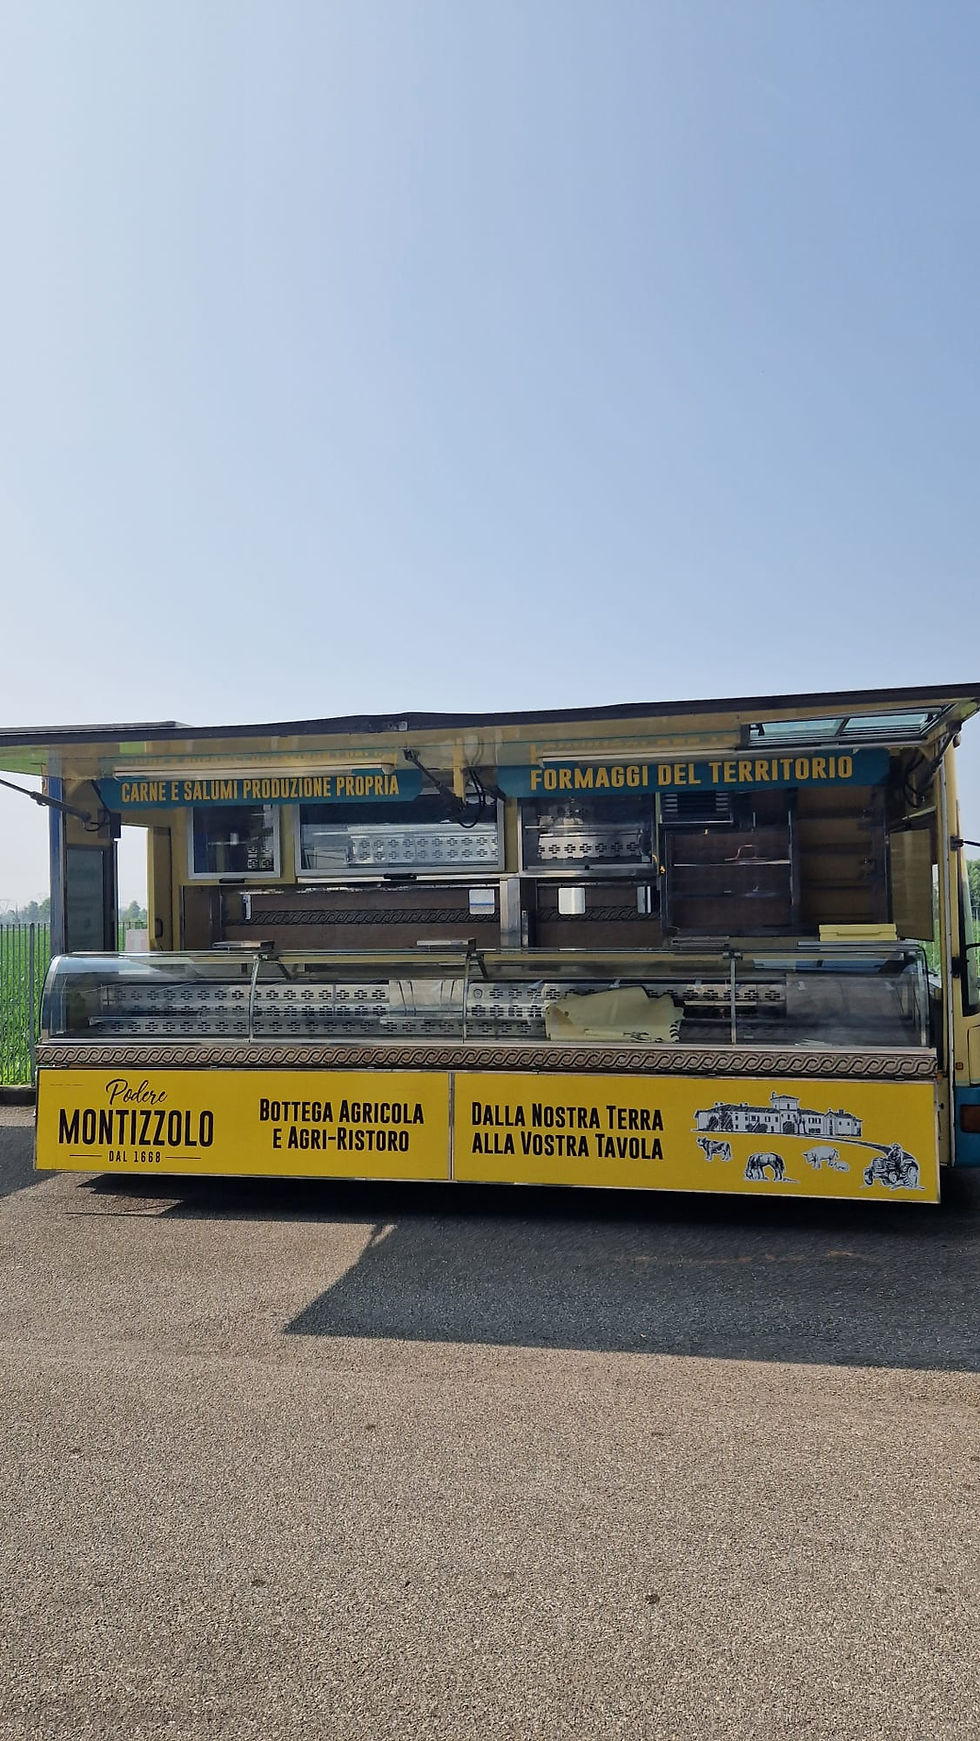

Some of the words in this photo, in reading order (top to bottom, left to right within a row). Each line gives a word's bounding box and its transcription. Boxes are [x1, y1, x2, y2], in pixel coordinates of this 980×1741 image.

[530, 765, 648, 791] FORMAGGI
[658, 763, 701, 786] DEL
[708, 756, 854, 784] TERRITORIO
[121, 782, 167, 802] CARNE
[171, 781, 179, 801] E
[184, 779, 237, 800] SALUMI
[243, 776, 331, 799] PRODUZIONE
[336, 775, 400, 797] PROPRIA
[105, 1078, 168, 1105] Podere
[259, 1098, 333, 1123] BOTTEGA
[338, 1099, 424, 1124] AGRICOLA
[471, 1102, 526, 1127] DALLA
[531, 1103, 600, 1129] NOSTRA
[606, 1105, 664, 1131] TERRA
[58, 1108, 214, 1147] MONTIZZOLO
[272, 1128, 282, 1149] E
[288, 1126, 409, 1152] AGRI-RISTORO
[108, 1150, 128, 1162] DAL
[133, 1151, 161, 1163] 1668
[472, 1132, 515, 1155] ALLA
[521, 1131, 589, 1157] VOSTRA
[595, 1133, 664, 1160] TAVOLA
